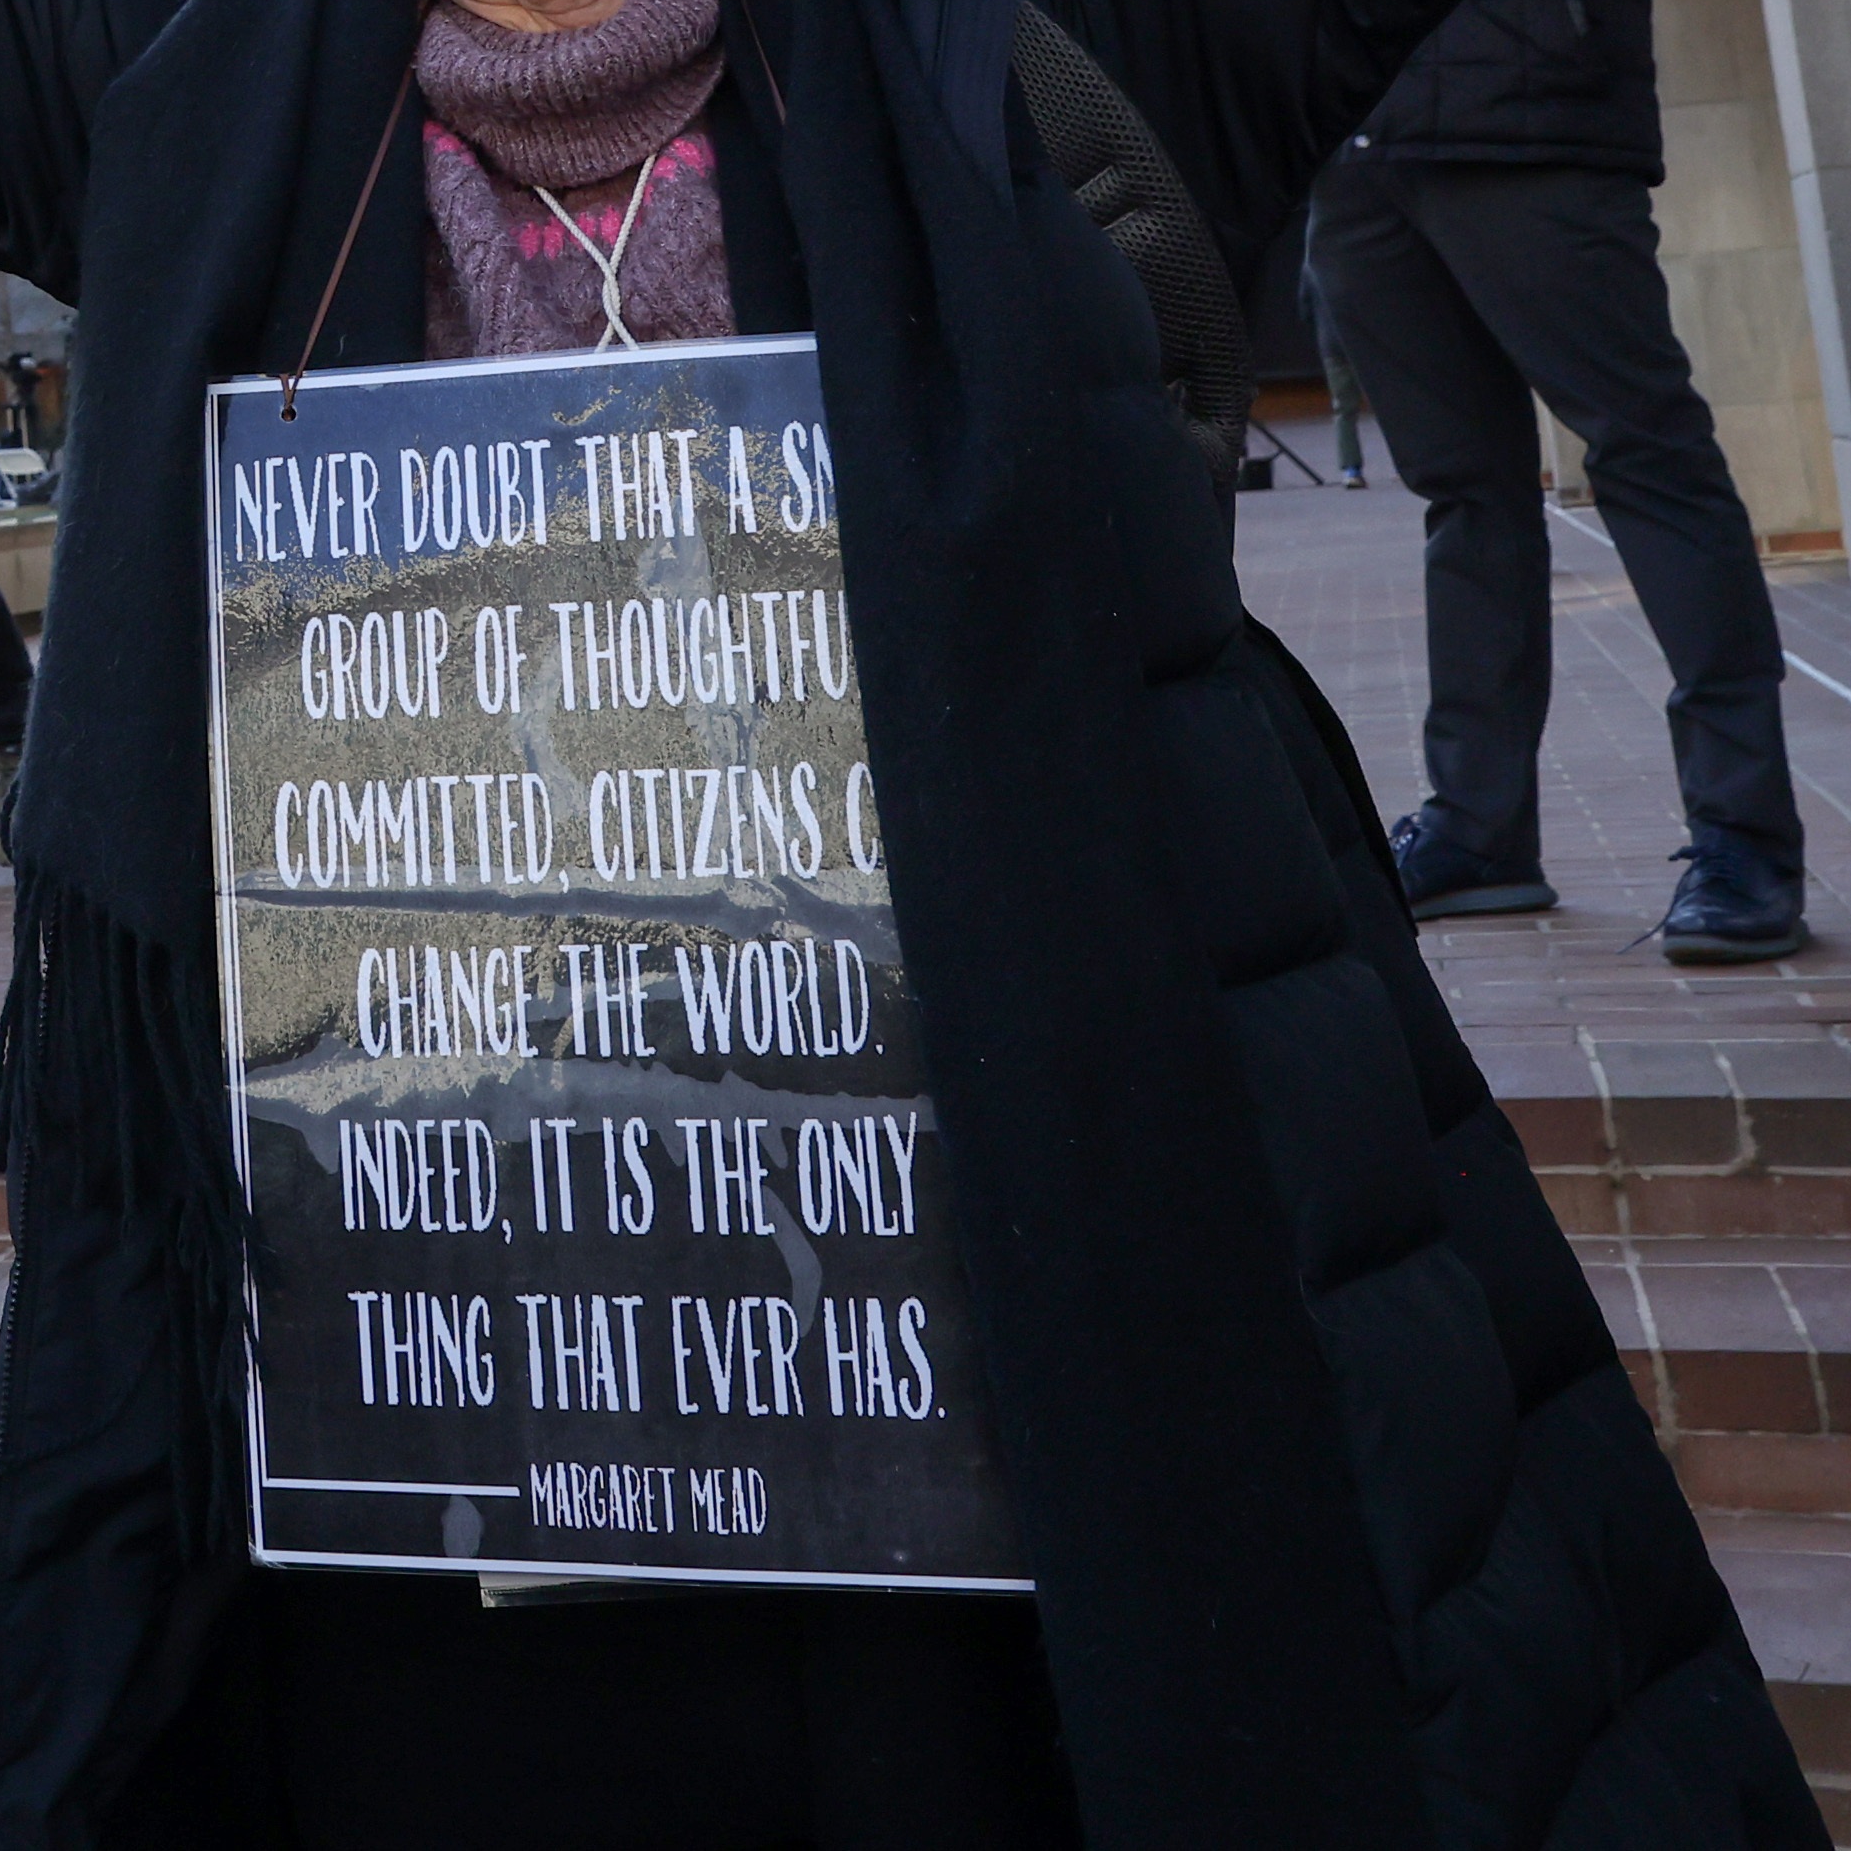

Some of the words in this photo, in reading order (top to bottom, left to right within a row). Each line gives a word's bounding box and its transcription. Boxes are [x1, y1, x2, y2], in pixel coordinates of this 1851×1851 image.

[233, 451, 379, 562] NEVER
[400, 439, 552, 553] DOUBT
[576, 429, 698, 542] THAT
[728, 425, 757, 535] A
[301, 607, 448, 720] GROUP
[474, 604, 527, 715] OF
[274, 771, 571, 893] COMMITTED,
[590, 760, 821, 883] CITIZENS
[356, 945, 538, 1060] CHANGE
[558, 942, 656, 1059] THE
[674, 939, 885, 1058] WORLD.
[339, 1117, 513, 1245] INDEED,
[530, 1117, 577, 1235] IT
[602, 1117, 655, 1236] IS
[675, 1117, 776, 1236] THE
[798, 1111, 918, 1237] ONLY
[346, 1290, 495, 1409] THING
[515, 1294, 645, 1413] THAT
[671, 1297, 805, 1418] EVER
[823, 1297, 947, 1422] HAS.
[529, 1462, 676, 1534] MARGARET
[689, 1466, 768, 1537] MEAD
